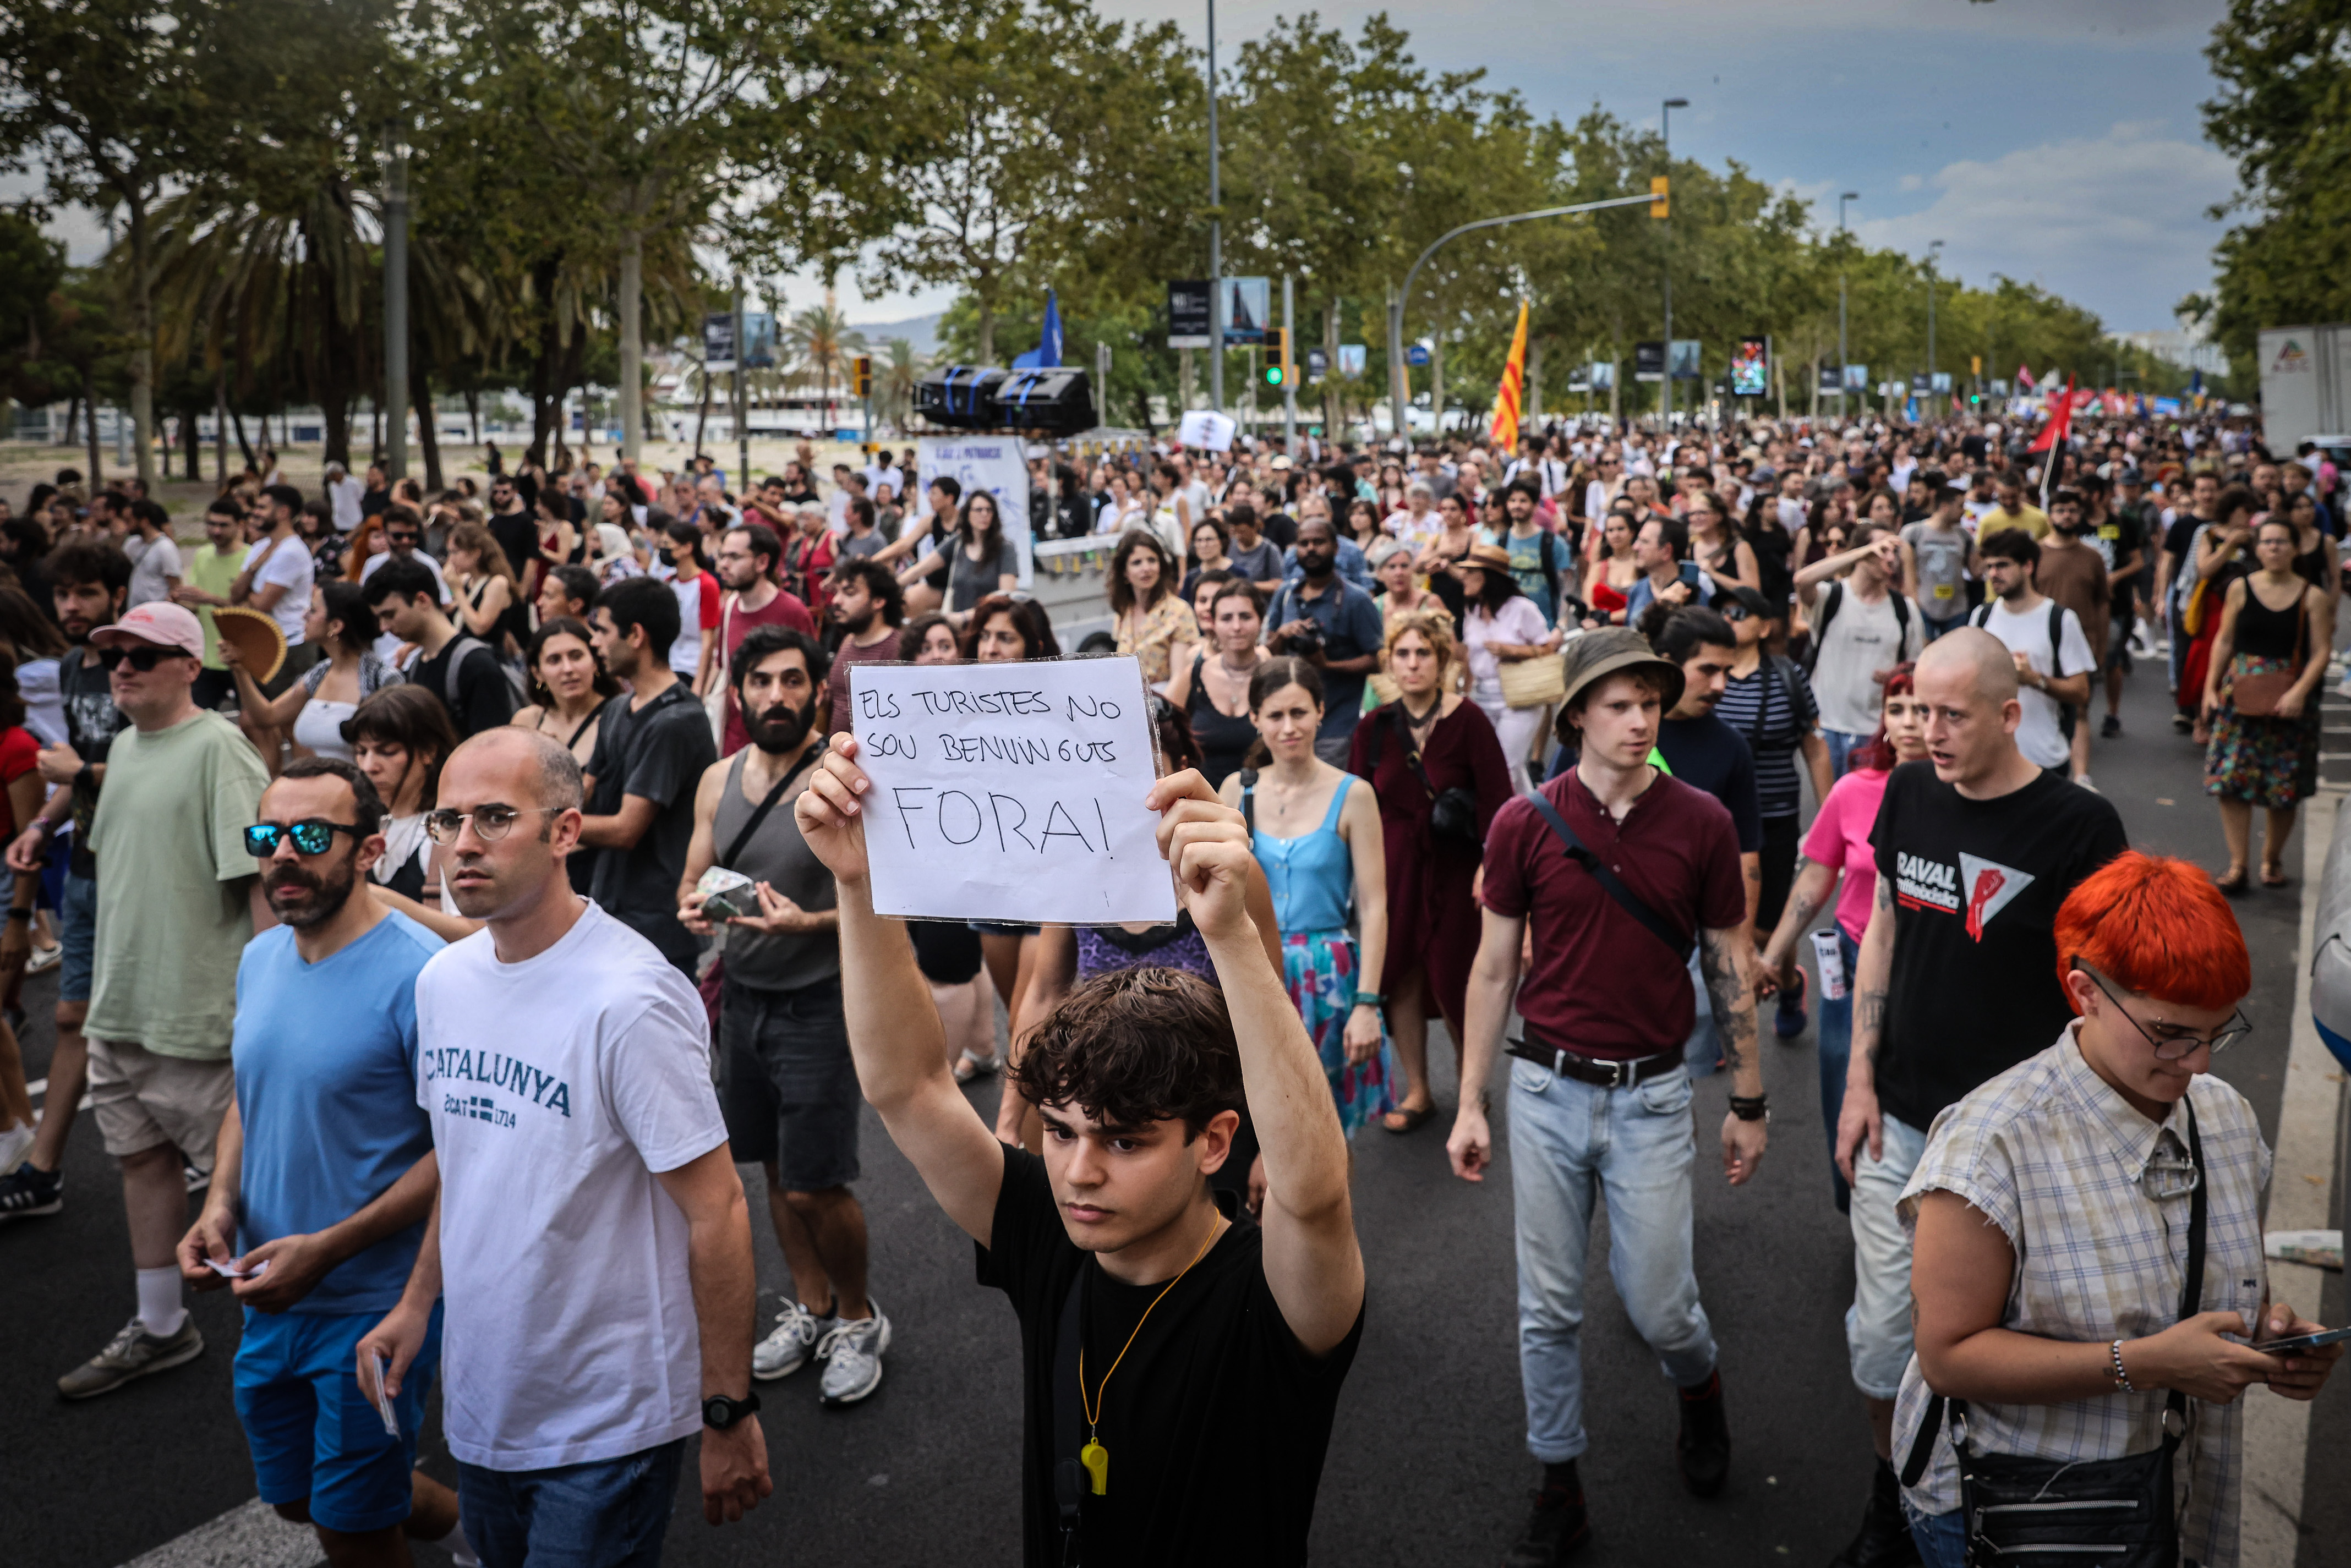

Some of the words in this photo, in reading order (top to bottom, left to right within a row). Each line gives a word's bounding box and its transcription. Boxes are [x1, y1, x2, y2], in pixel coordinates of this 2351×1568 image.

[859, 689, 900, 719] ELS
[911, 690, 1051, 716] TURISTES
[1067, 695, 1121, 722] NO
[867, 732, 916, 759] SOU
[892, 787, 1113, 859] FORA!
[1897, 851, 1956, 891] RAVAL
[426, 1047, 571, 1118] CATALUNYA
